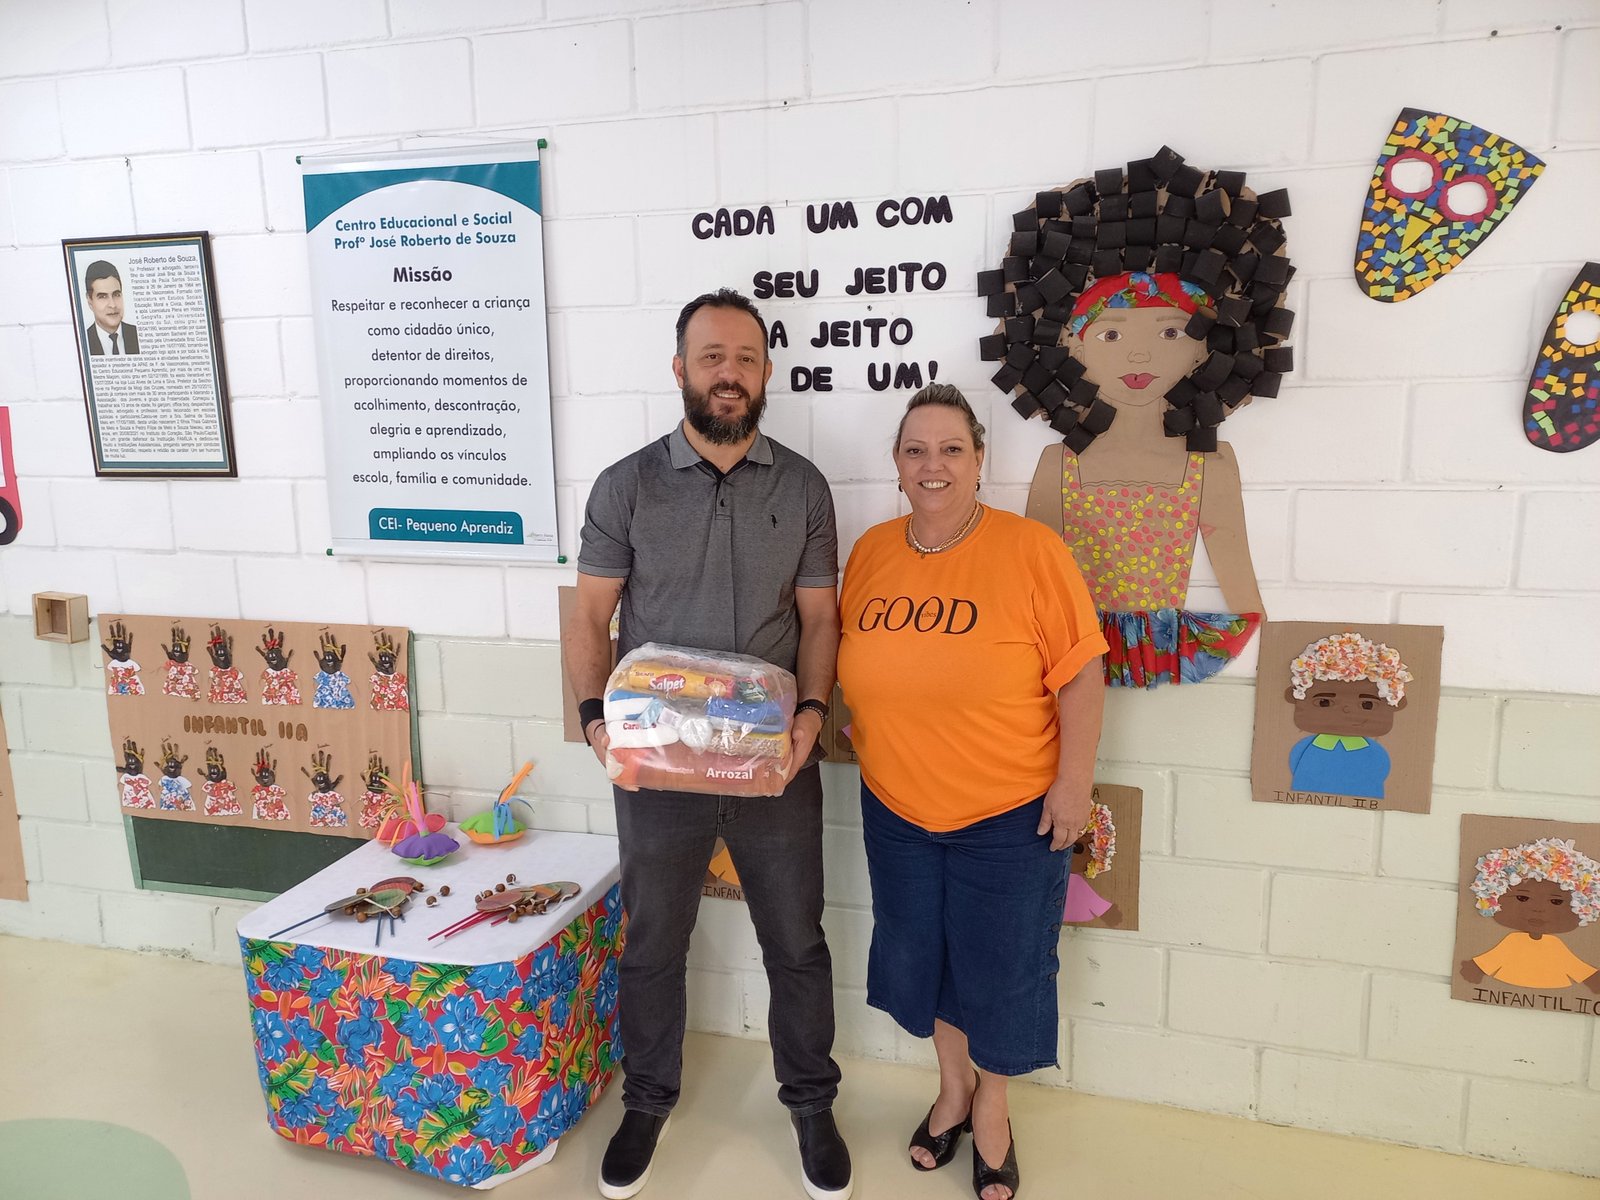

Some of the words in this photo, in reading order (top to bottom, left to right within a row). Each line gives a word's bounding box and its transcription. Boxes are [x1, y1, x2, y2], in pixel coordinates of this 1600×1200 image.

[336, 220, 376, 231] Centro
[380, 214, 457, 229] Educacional
[462, 217, 469, 226] e
[474, 211, 512, 225] Social
[692, 205, 775, 240] CADA
[806, 201, 858, 234] UM
[876, 195, 953, 228] COM
[370, 236, 396, 248] José
[401, 234, 451, 246] Roberto
[456, 232, 471, 244] de
[476, 232, 515, 244] Souza
[128, 257, 142, 265] José
[144, 256, 167, 264] Roberto
[168, 255, 175, 263] de
[394, 267, 452, 282] Missão
[753, 269, 819, 299] SEU
[845, 262, 947, 295] JEITO
[332, 299, 385, 314] Respeitar
[389, 302, 396, 310] e
[401, 297, 468, 310] reconhecer
[473, 300, 479, 308] a
[485, 296, 530, 311] criança
[368, 328, 400, 336] como
[405, 322, 452, 335] cidadão
[457, 322, 494, 336] único,
[811, 318, 913, 348] JEITO
[372, 349, 421, 361] detentor
[426, 348, 440, 360] de
[445, 348, 493, 362] direitos,
[345, 373, 438, 388] proporcionando
[443, 375, 507, 385] momentos
[512, 373, 527, 385] de
[791, 366, 832, 392] DE
[868, 361, 938, 390] UM!
[354, 398, 430, 412] acolhimento,
[435, 399, 520, 414] descontração,
[370, 423, 410, 437] alegria
[415, 427, 421, 435] e
[426, 424, 506, 438] aprendizado,
[374, 447, 436, 462] ampliando
[441, 452, 453, 460] os
[458, 449, 506, 461] vínculos
[353, 471, 392, 484] escola,
[396, 471, 436, 484] família
[441, 476, 448, 484] e
[453, 473, 531, 486] comunidade.
[379, 517, 402, 529] CEI-
[407, 518, 457, 534] Pequeno
[461, 520, 513, 535] Aprendiz
[859, 596, 978, 634] GOOD
[649, 677, 685, 692] Salpet
[184, 716, 267, 737] INFANTIL
[706, 768, 752, 780] Arrozal
[1273, 791, 1348, 806] INFANTIL
[1472, 988, 1572, 1011] INFANTIL
